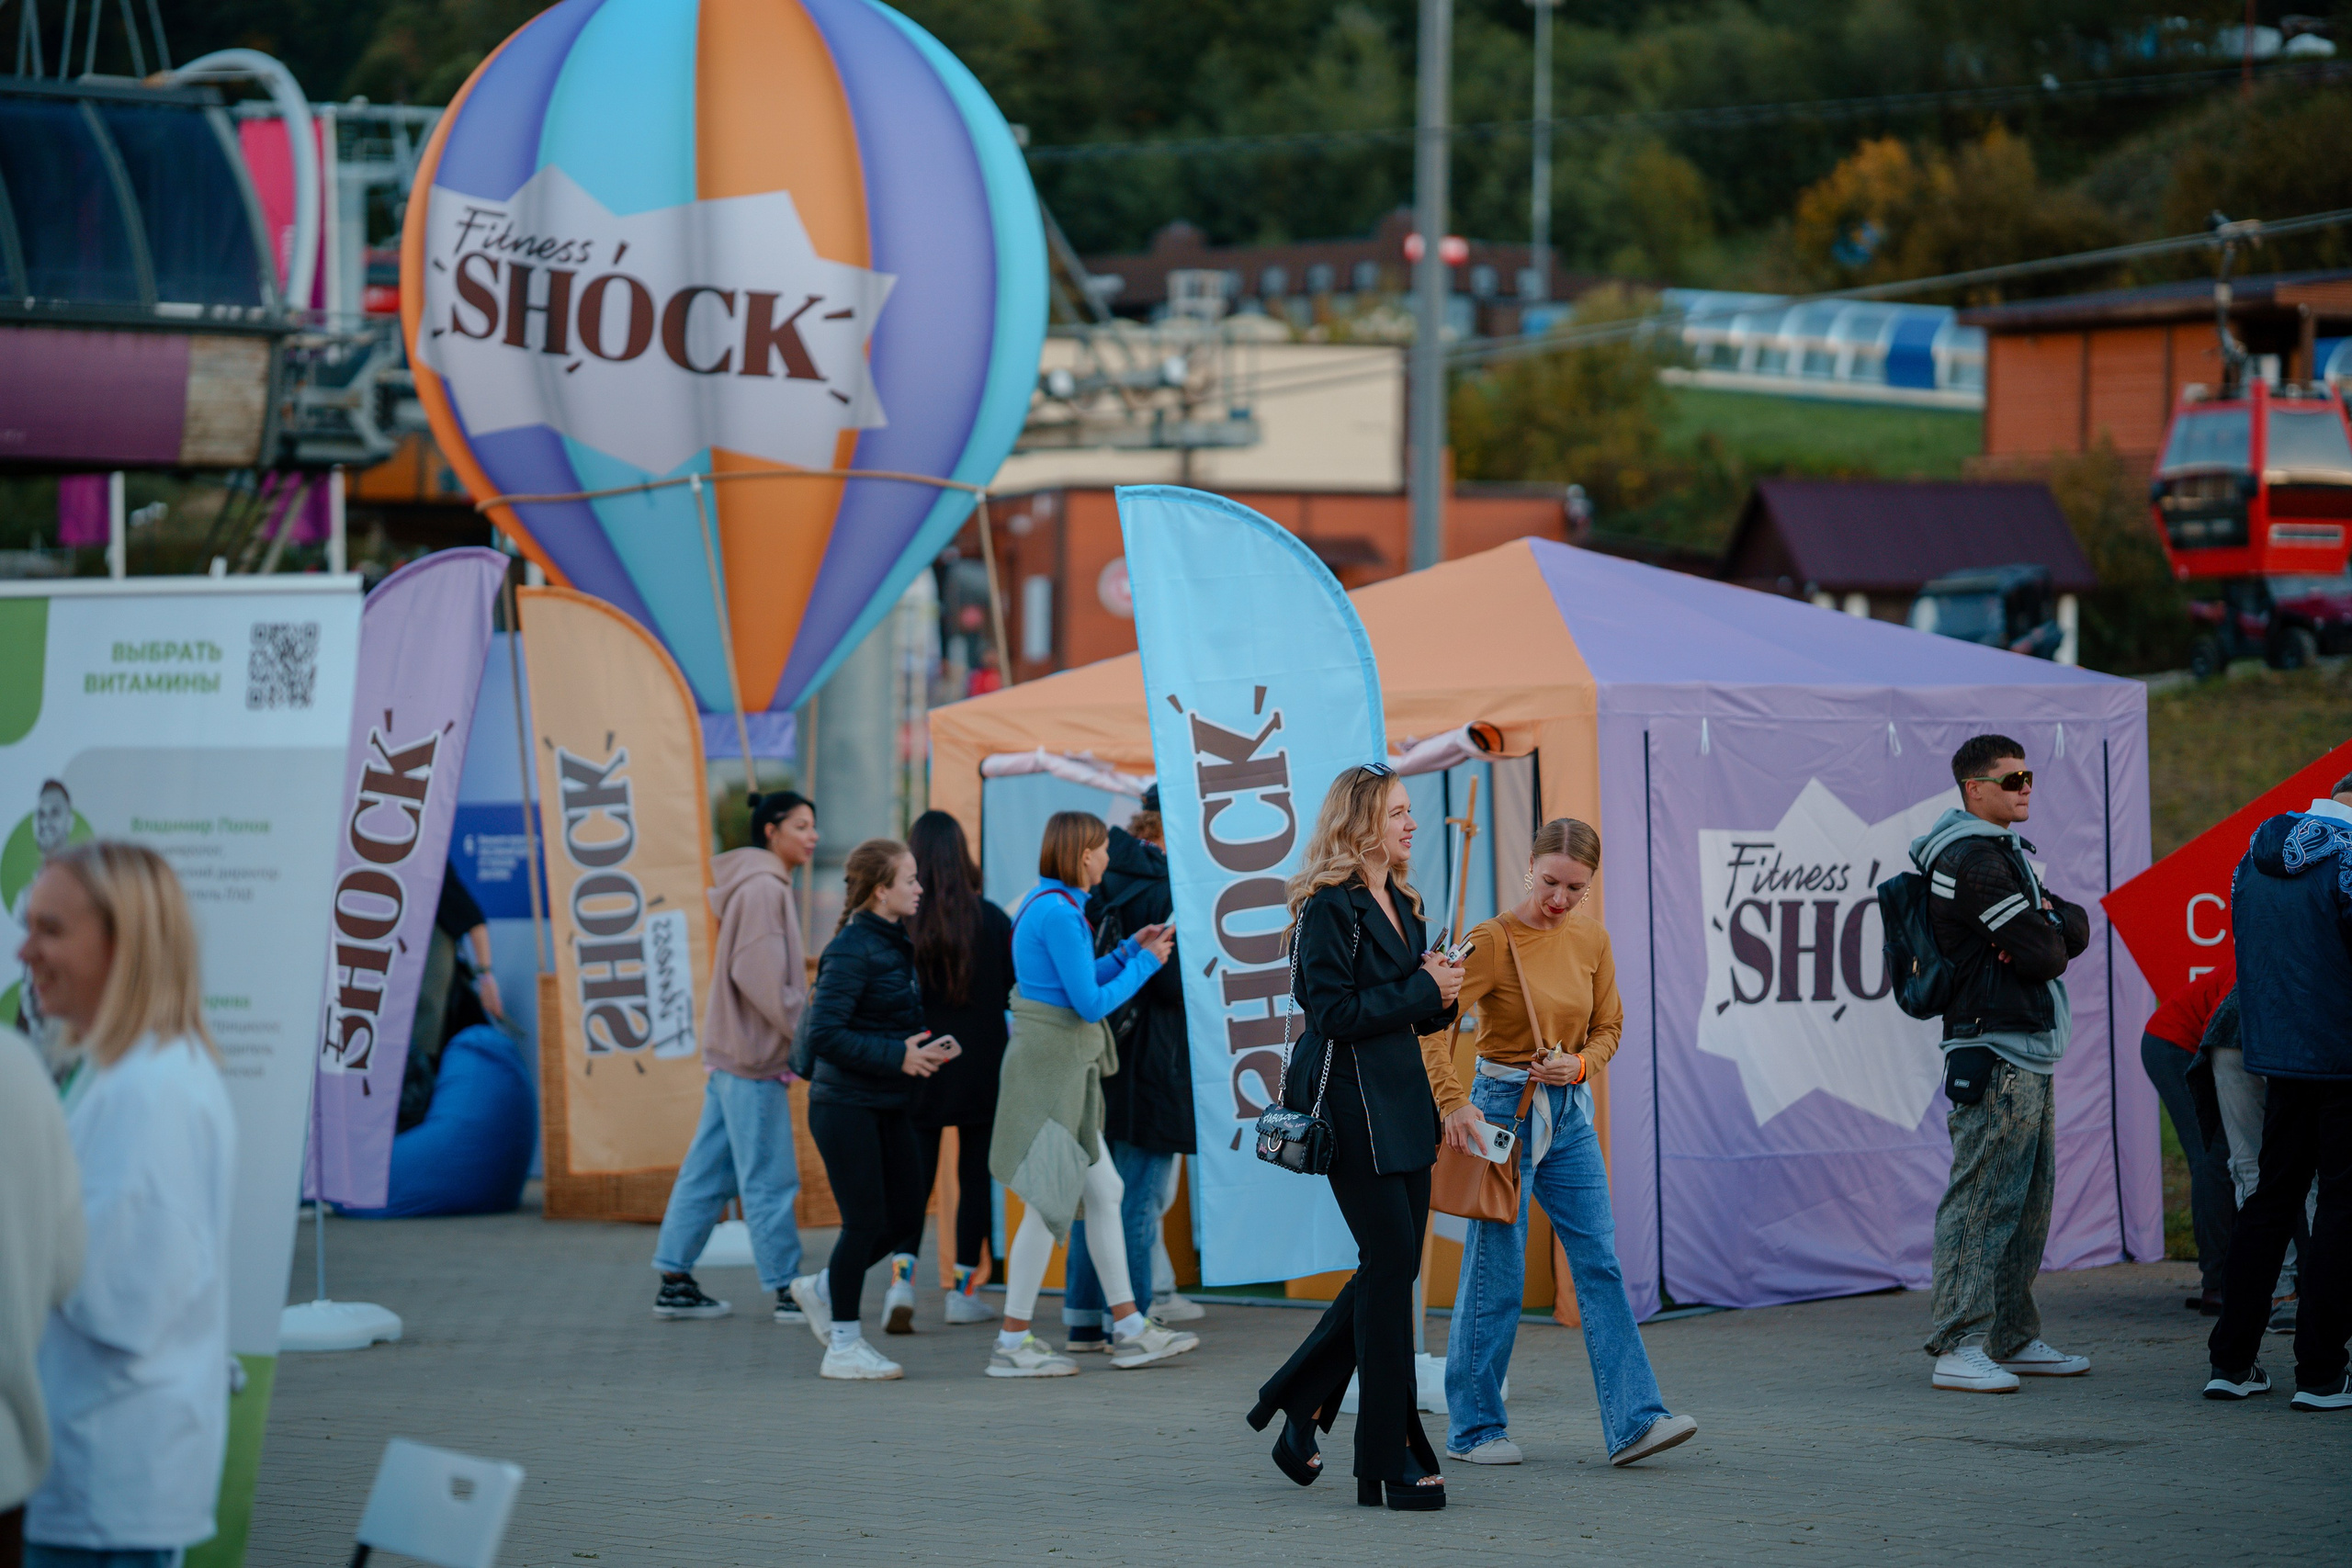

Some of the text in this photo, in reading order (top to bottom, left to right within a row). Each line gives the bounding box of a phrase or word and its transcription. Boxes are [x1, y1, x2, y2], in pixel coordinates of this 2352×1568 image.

[455, 206, 594, 265] Fitness
[451, 252, 830, 382] SHOCK
[84, 671, 221, 694] ВИТАМИНЫ
[110, 640, 223, 664] ВЫБРАТЬ
[1725, 842, 1852, 909] Fitness
[1729, 897, 1893, 1005] SHO
